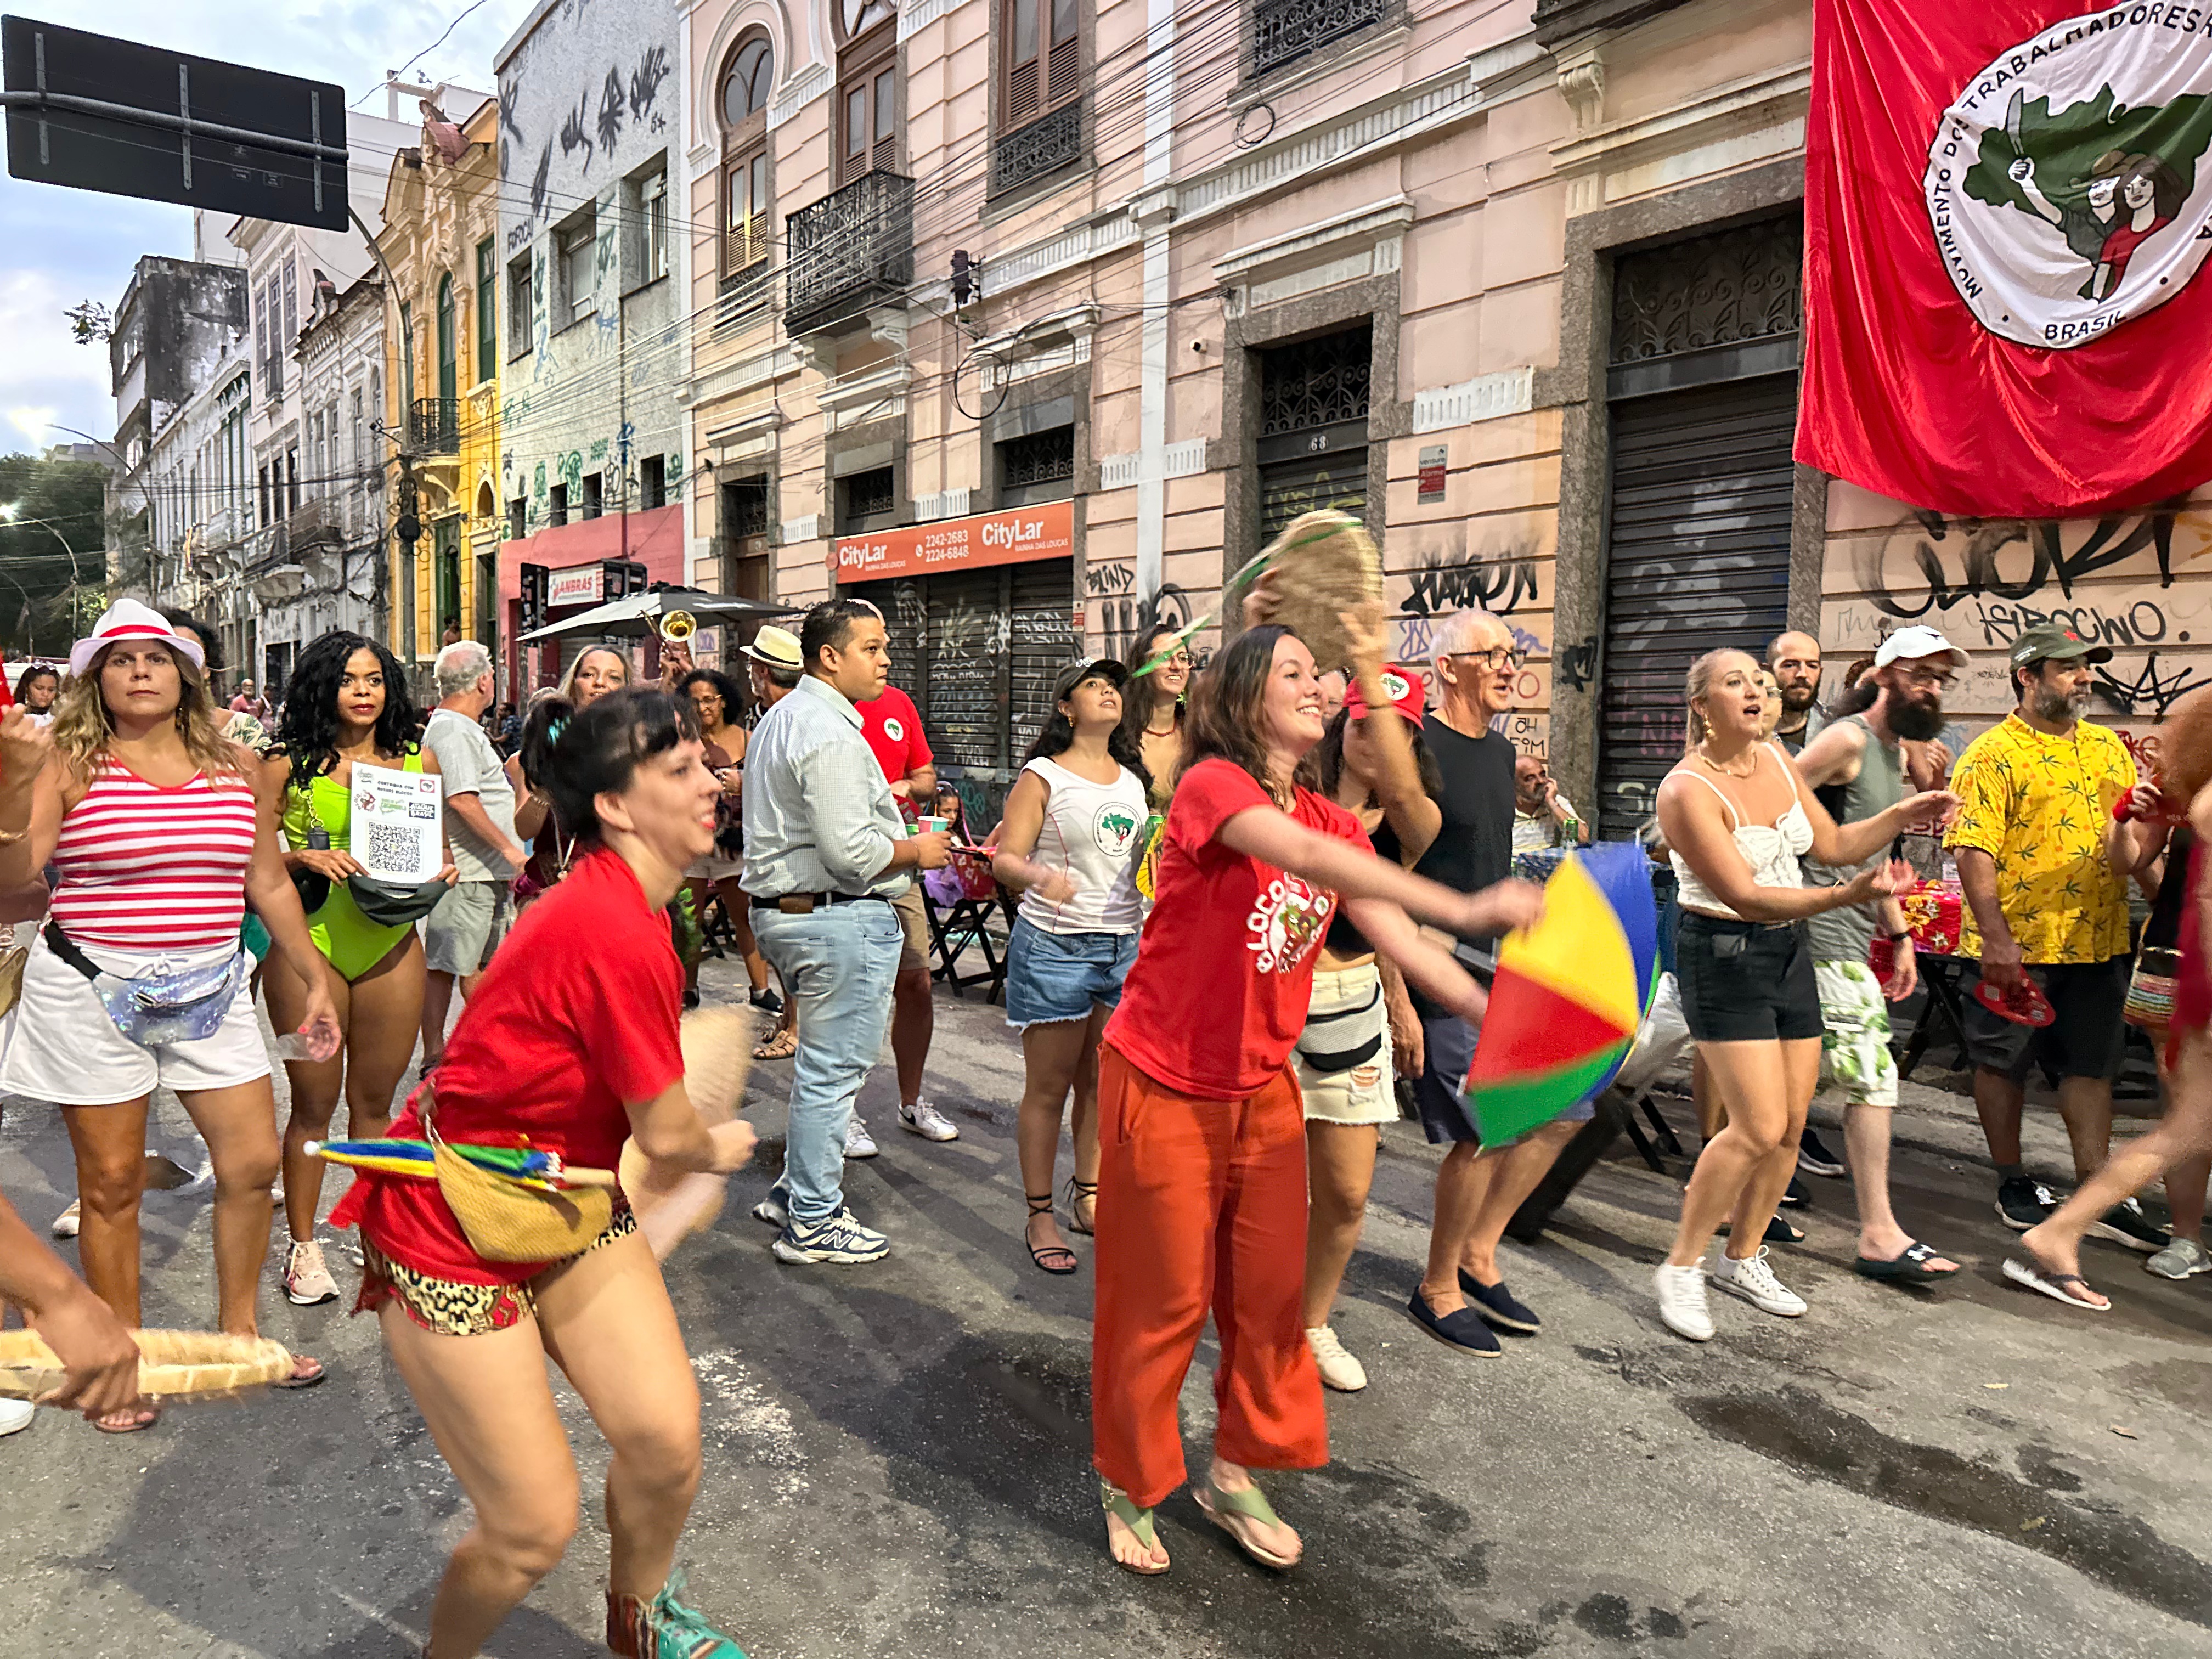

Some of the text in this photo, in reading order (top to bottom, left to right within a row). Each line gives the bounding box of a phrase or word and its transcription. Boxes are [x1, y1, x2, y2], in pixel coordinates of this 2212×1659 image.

[1934, 168, 1983, 300] MOVIMENTO
[2045, 311, 2128, 340] BRASIL
[1310, 435, 1327, 451] 68
[839, 519, 1045, 569] CityLar 2242-2683 CityLar
[926, 545, 970, 562] 2224-6848
[1015, 538, 1069, 552] RAINHA DAS LOUÇAS
[1246, 879, 1286, 974] BLOCO
